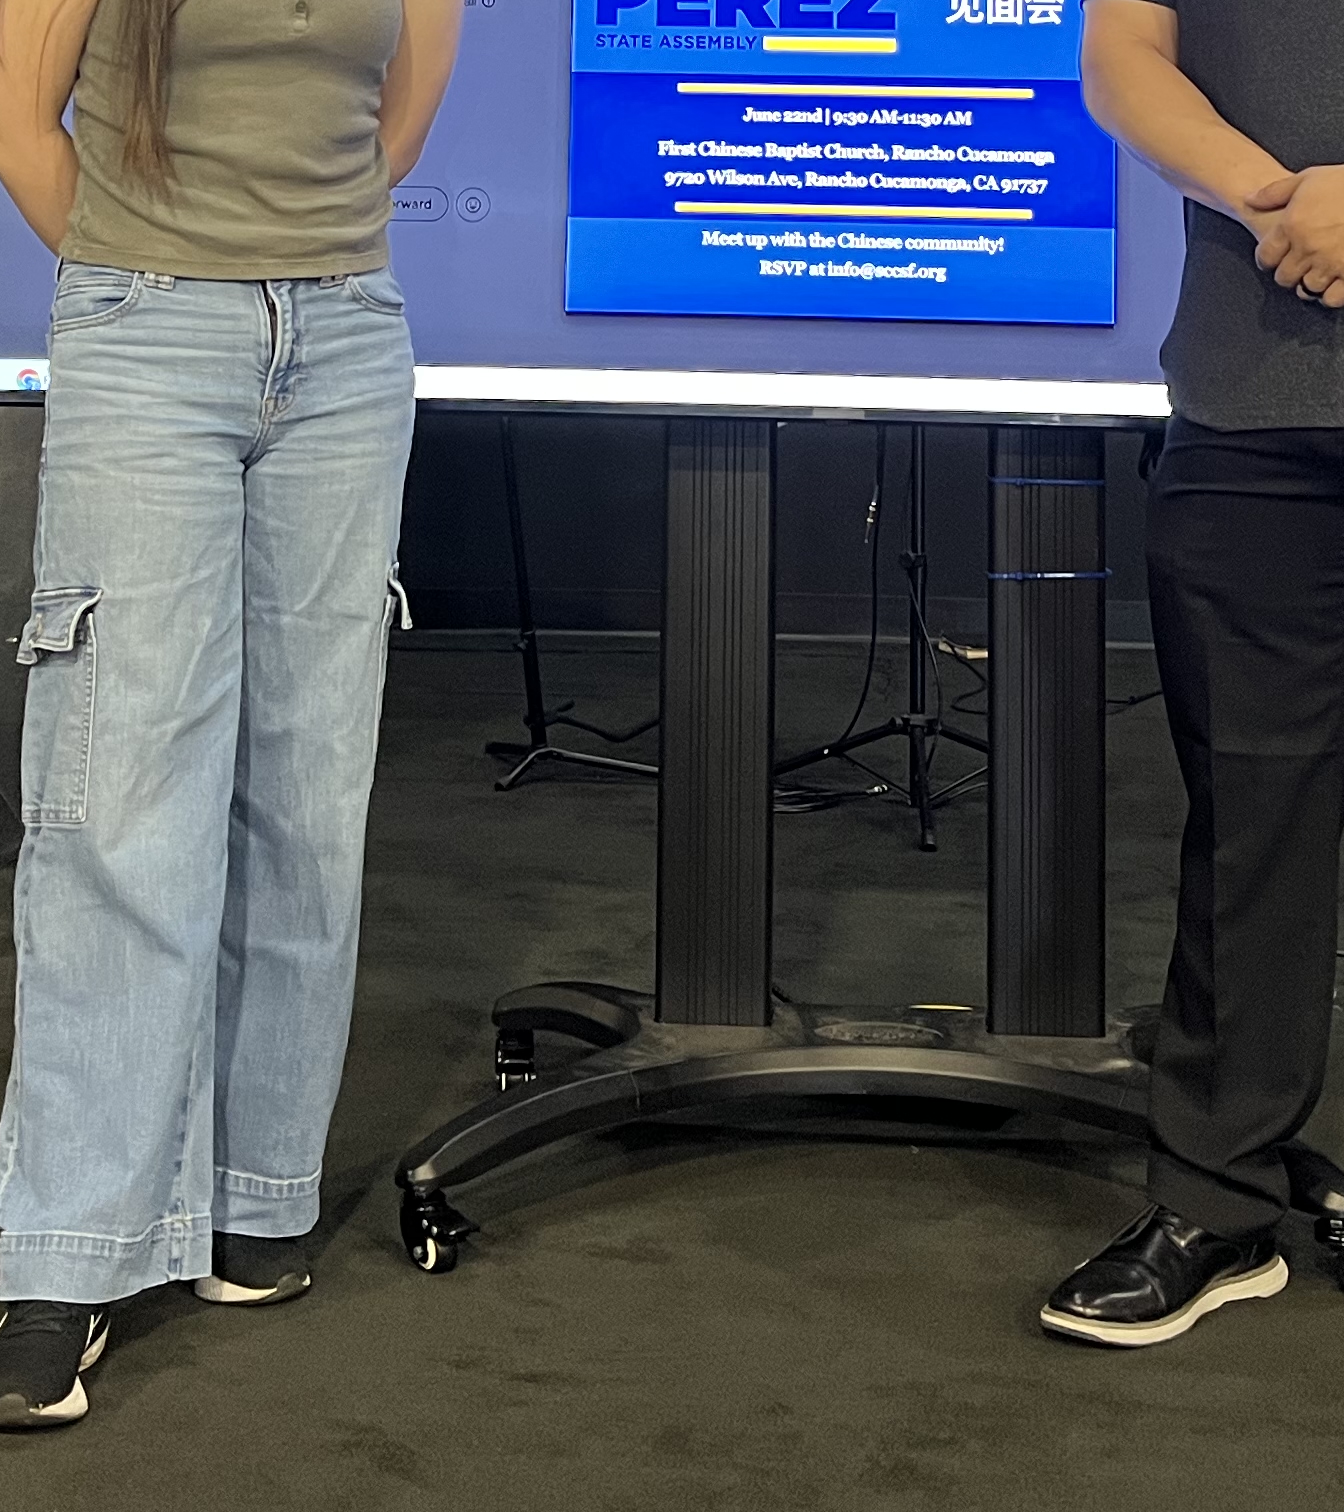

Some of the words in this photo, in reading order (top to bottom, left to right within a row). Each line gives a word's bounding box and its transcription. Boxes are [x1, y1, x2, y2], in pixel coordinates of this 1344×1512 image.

[595, 33, 653, 49] STATE
[658, 34, 757, 51] ASSEMBLY
[742, 106, 782, 123] June
[782, 107, 823, 124] 22nd
[832, 110, 869, 126] 9:30
[943, 110, 973, 127] AM
[657, 139, 697, 157] First
[697, 140, 763, 158] Chinese
[764, 141, 823, 162] Baptist
[823, 143, 890, 163] Church,
[891, 144, 956, 162] Rancho
[956, 145, 1056, 167] Cucamonga
[664, 170, 706, 188] 9720
[705, 168, 766, 187] Wilson
[765, 170, 803, 190] Ave,
[804, 170, 869, 189] Rancho
[869, 172, 971, 194] Cucamonga,
[972, 174, 1000, 192] CA
[1000, 178, 1049, 195] 91737
[392, 197, 432, 210] rward
[701, 230, 743, 247] Meet
[747, 233, 768, 251] up
[769, 231, 807, 248] with
[808, 232, 836, 249] the
[837, 231, 903, 250] Chinese
[904, 235, 1005, 255] community!
[759, 259, 808, 276] RSVP
[808, 261, 827, 277] at
[827, 260, 947, 283] info@sccsf.org
